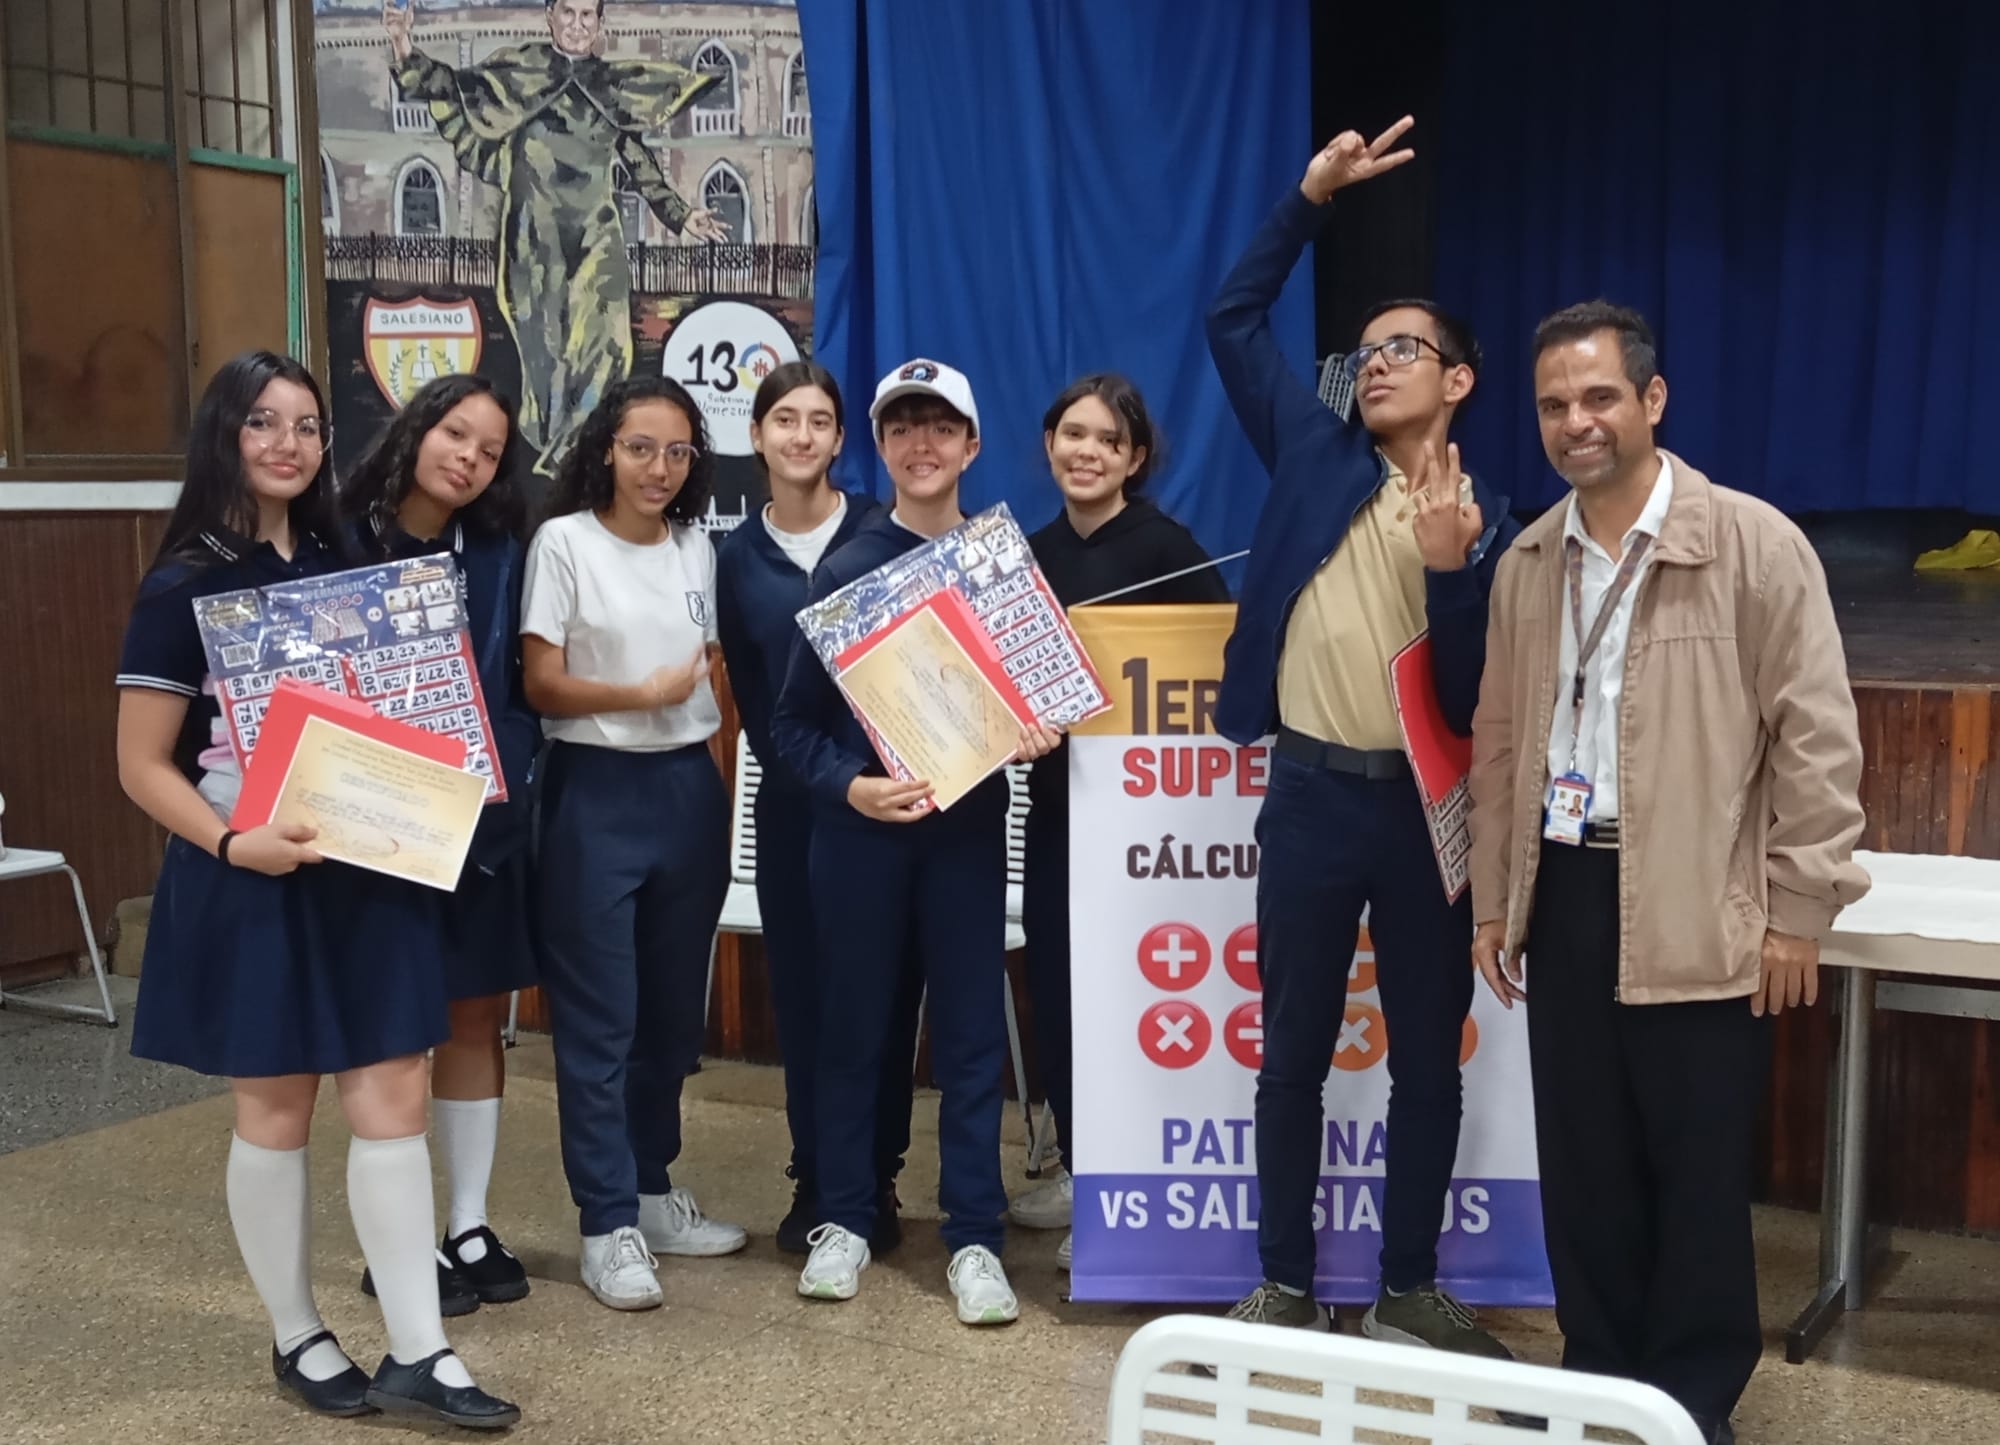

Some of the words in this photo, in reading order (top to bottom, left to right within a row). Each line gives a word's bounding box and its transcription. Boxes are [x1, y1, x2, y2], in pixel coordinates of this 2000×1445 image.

[380, 312, 464, 325] SALESIANO
[1003, 632, 1020, 648] 23
[1021, 622, 1038, 638] 24
[1039, 612, 1054, 630] 25
[1013, 605, 1028, 621] 27
[358, 653, 372, 672] 31
[376, 649, 395, 662] 32
[444, 632, 457, 652] 35
[1016, 655, 1033, 669] 18
[1036, 644, 1051, 660] 17
[1050, 634, 1065, 650] 16
[1043, 661, 1060, 675] 14
[1061, 652, 1076, 668] 15
[232, 677, 247, 698] 66
[252, 674, 270, 689] 67
[298, 664, 317, 679] 69
[322, 659, 338, 679] 70
[364, 675, 377, 695] 30
[428, 667, 446, 681] 27
[449, 658, 463, 678] 26
[239, 703, 253, 724] 75
[389, 698, 406, 712] 22
[412, 693, 429, 707] 23
[432, 689, 451, 702] 24
[455, 681, 468, 701] 25
[441, 716, 458, 729] 17
[462, 707, 475, 726] 16
[244, 727, 257, 748] 76
[1122, 746, 1274, 798] SUPE
[1126, 833, 1259, 879] CÁLCU
[1099, 1190, 1149, 1229] VS
[1166, 1181, 1491, 1234] SALSIAS
